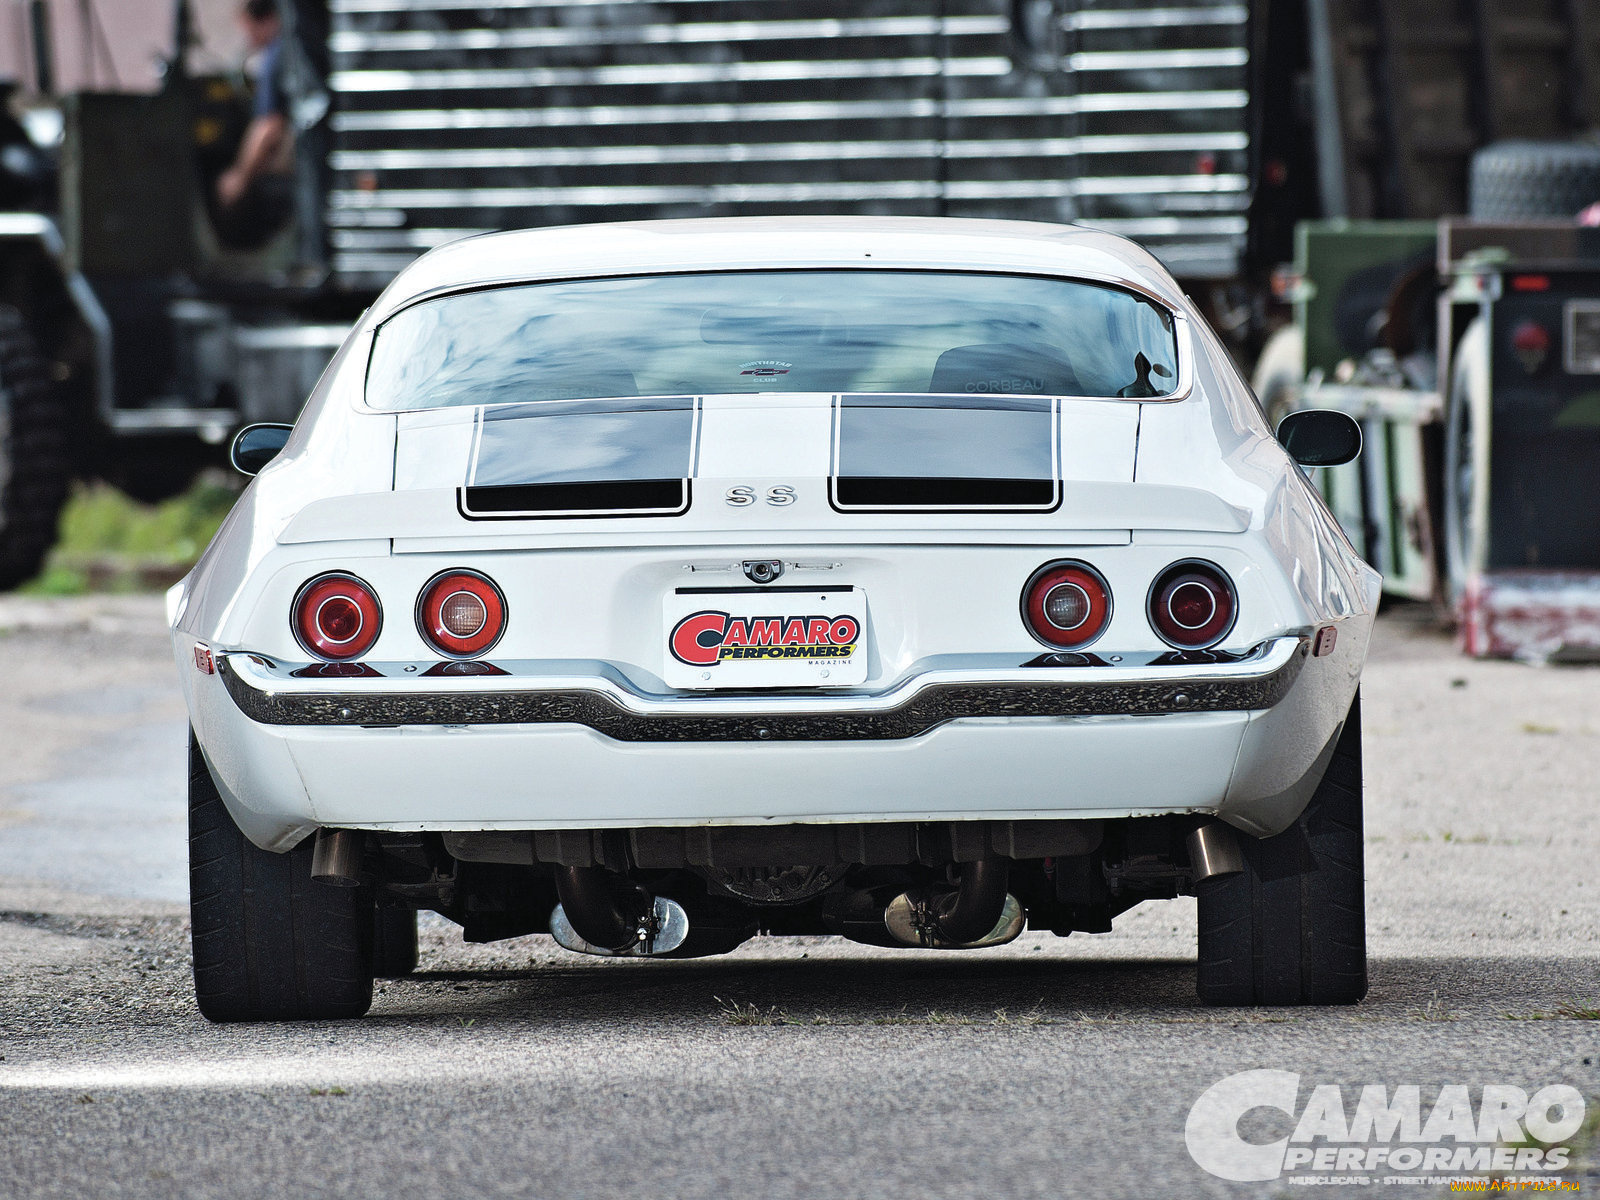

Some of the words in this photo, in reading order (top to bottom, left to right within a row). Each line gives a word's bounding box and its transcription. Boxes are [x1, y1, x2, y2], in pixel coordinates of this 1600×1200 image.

[965, 379, 1045, 393] CORBEAU
[669, 610, 860, 667] CAMARO
[718, 645, 852, 660] PERFORMERS
